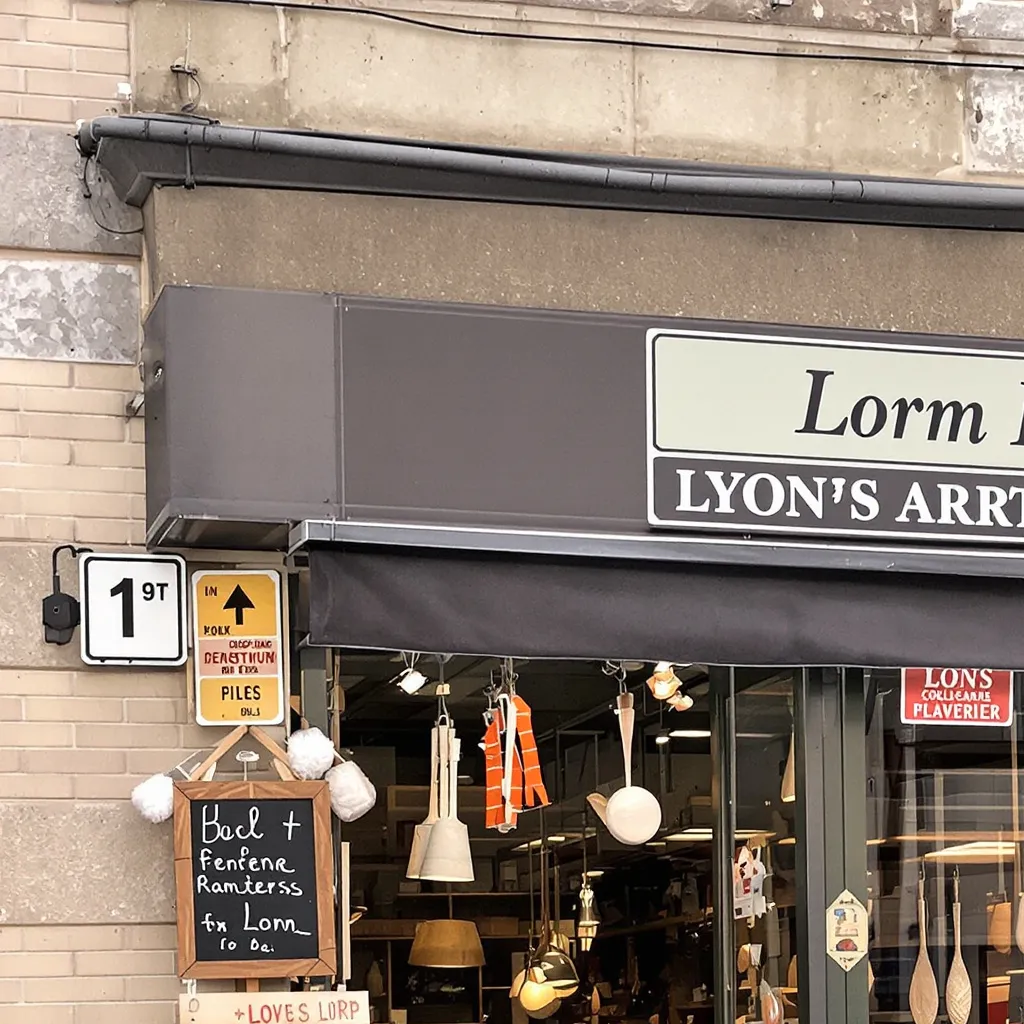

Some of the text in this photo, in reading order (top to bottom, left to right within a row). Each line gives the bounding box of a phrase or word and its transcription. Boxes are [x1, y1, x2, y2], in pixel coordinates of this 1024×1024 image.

[795, 369, 988, 445] Lorm
[675, 468, 881, 522] LYON'S
[221, 685, 261, 701] PILES
